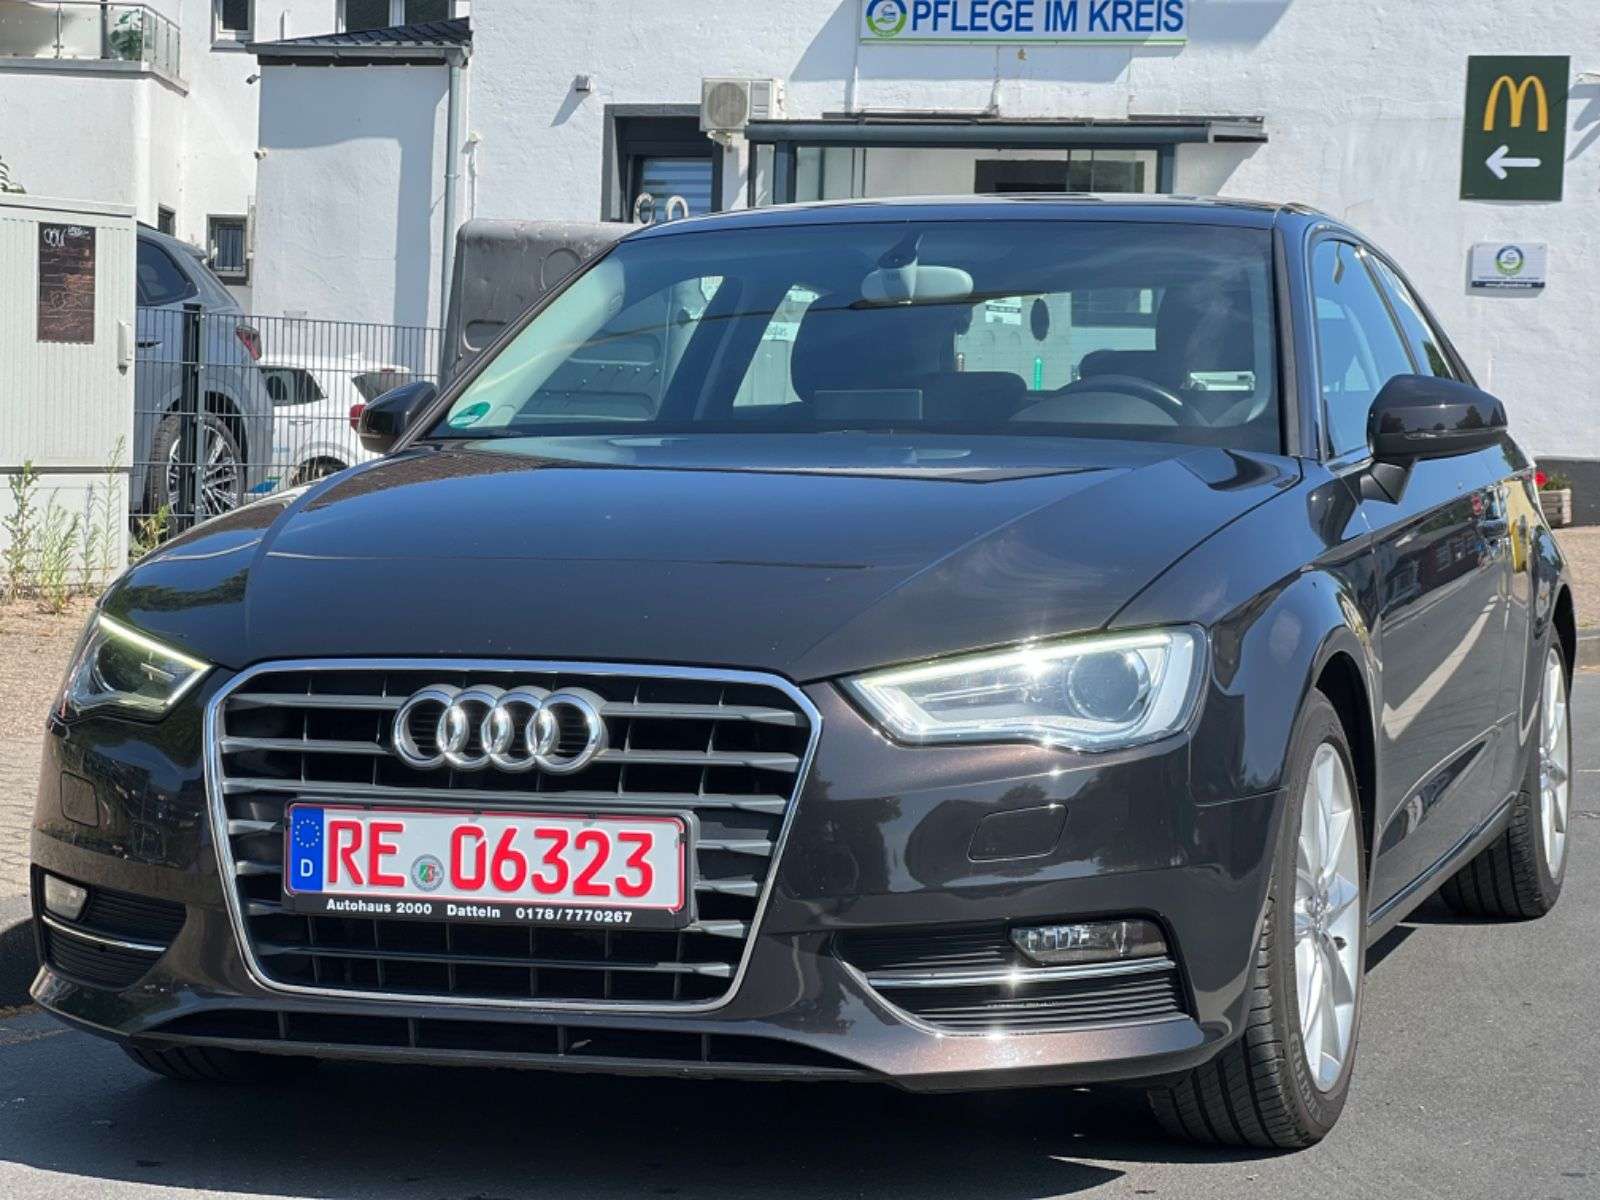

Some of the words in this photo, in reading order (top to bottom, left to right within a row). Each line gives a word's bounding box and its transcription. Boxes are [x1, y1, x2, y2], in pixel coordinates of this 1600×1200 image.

[912, 0, 1034, 32] PFLEGE
[1044, 0, 1078, 32] IM
[1088, 0, 1184, 32] KREIS
[300, 858, 313, 877] D
[327, 819, 405, 887] RE
[449, 824, 655, 898] 06323
[326, 898, 391, 913] Autohaus
[396, 902, 432, 915] 2000
[447, 904, 500, 918] Datteln
[515, 907, 633, 923] 0178/7770267
